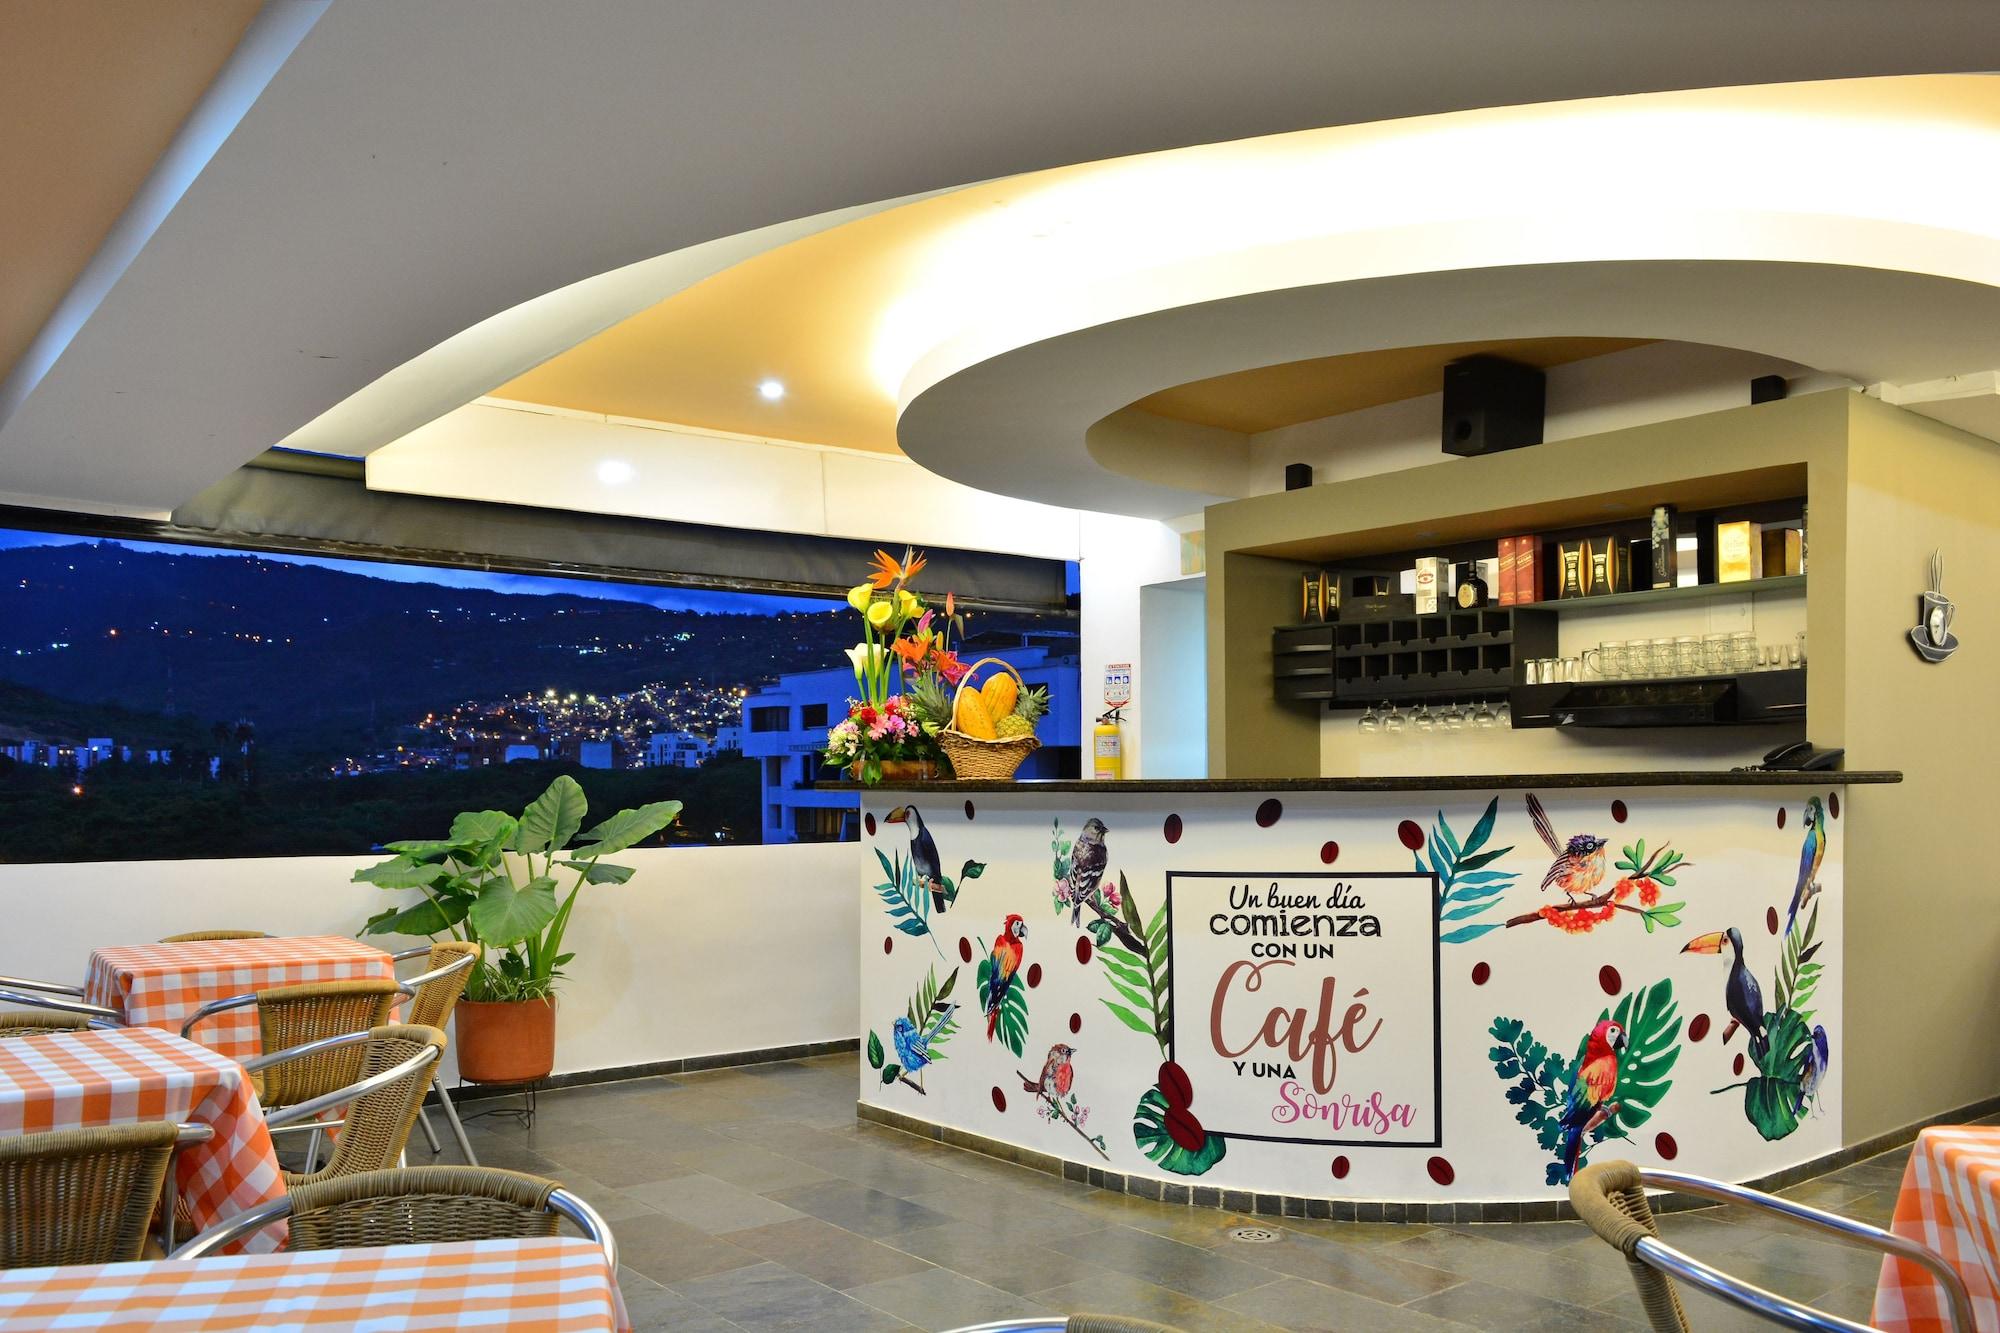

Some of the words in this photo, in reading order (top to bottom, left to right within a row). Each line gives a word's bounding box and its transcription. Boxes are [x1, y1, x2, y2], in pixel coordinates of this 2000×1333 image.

[1229, 884, 1262, 910] Un
[1266, 882, 1321, 909] buen
[1326, 882, 1365, 909] día
[1209, 909, 1382, 937] comienza
[1251, 942, 1297, 958] CON
[1304, 943, 1334, 959] UN
[1210, 959, 1383, 1095] Café
[1232, 1061, 1246, 1076] Y
[1252, 1061, 1296, 1079] UNA
[1271, 1081, 1417, 1135] Sonrisa
